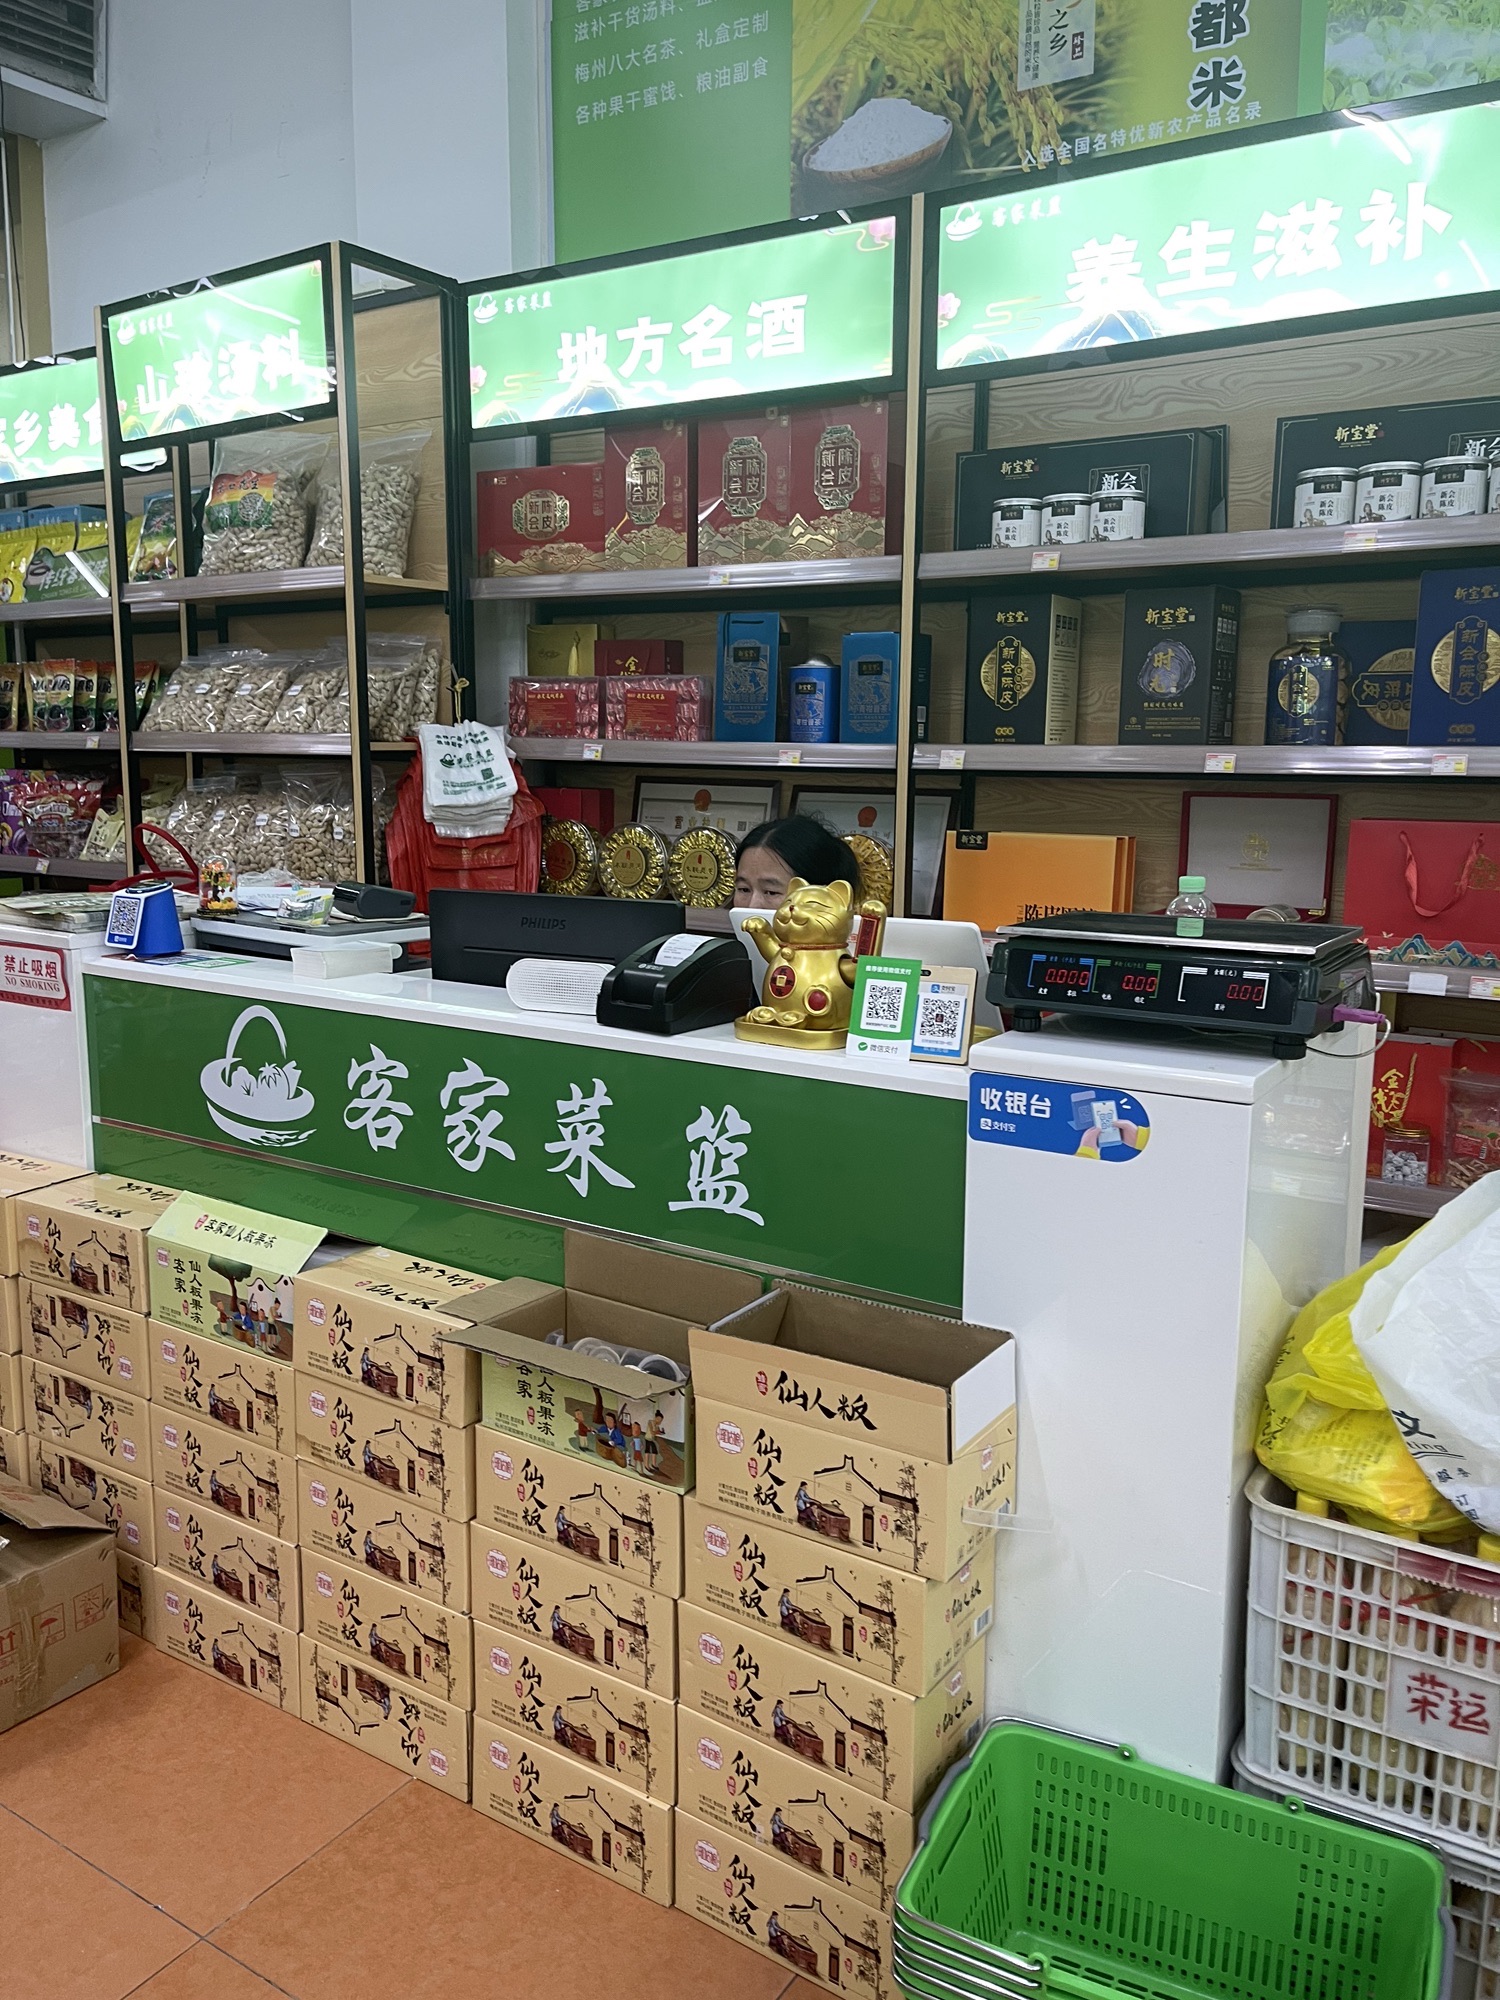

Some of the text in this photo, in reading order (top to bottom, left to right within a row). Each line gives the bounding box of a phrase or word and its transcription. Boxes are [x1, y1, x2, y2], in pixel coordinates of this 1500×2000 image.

[575, 10, 769, 84] 梅州八大名茶、 礼盒定制
[575, 56, 769, 125] 各种果干蜜饯、 粮油副食
[1022, 101, 1262, 166] 入选全国名特优新农产品名录
[1064, 181, 1453, 308] 养生滋补
[556, 294, 809, 383] 地方名酒
[1334, 423, 1379, 443] 新宝堂
[1000, 458, 1036, 475] 新宝堂
[1101, 471, 1138, 492] 新会
[1454, 585, 1494, 600] 新宝堂
[995, 611, 1025, 624] 新宝堂
[1145, 606, 1190, 626] 新宝堂
[1000, 646, 1016, 705] 新会陈皮
[1456, 629, 1480, 698] 新会陈皮
[520, 916, 567, 930] PHILIPS
[4, 954, 58, 980] 禁止吸烟
[1045, 968, 1090, 986] 0.000
[5, 976, 61, 992] NO SMOKING
[1121, 975, 1158, 992] 0.00
[1227, 984, 1265, 1002] 0.00
[869, 1044, 899, 1054] 微信支付
[980, 1087, 1052, 1119] 收银台
[343, 1043, 764, 1226] 客家菜篮
[992, 1121, 1017, 1133] 支付宝
[172, 1258, 187, 1293] 客家
[537, 1368, 556, 1437] 人粄果冻
[772, 1370, 878, 1431] 仙人粄
[1406, 1671, 1491, 1736] 荣运
